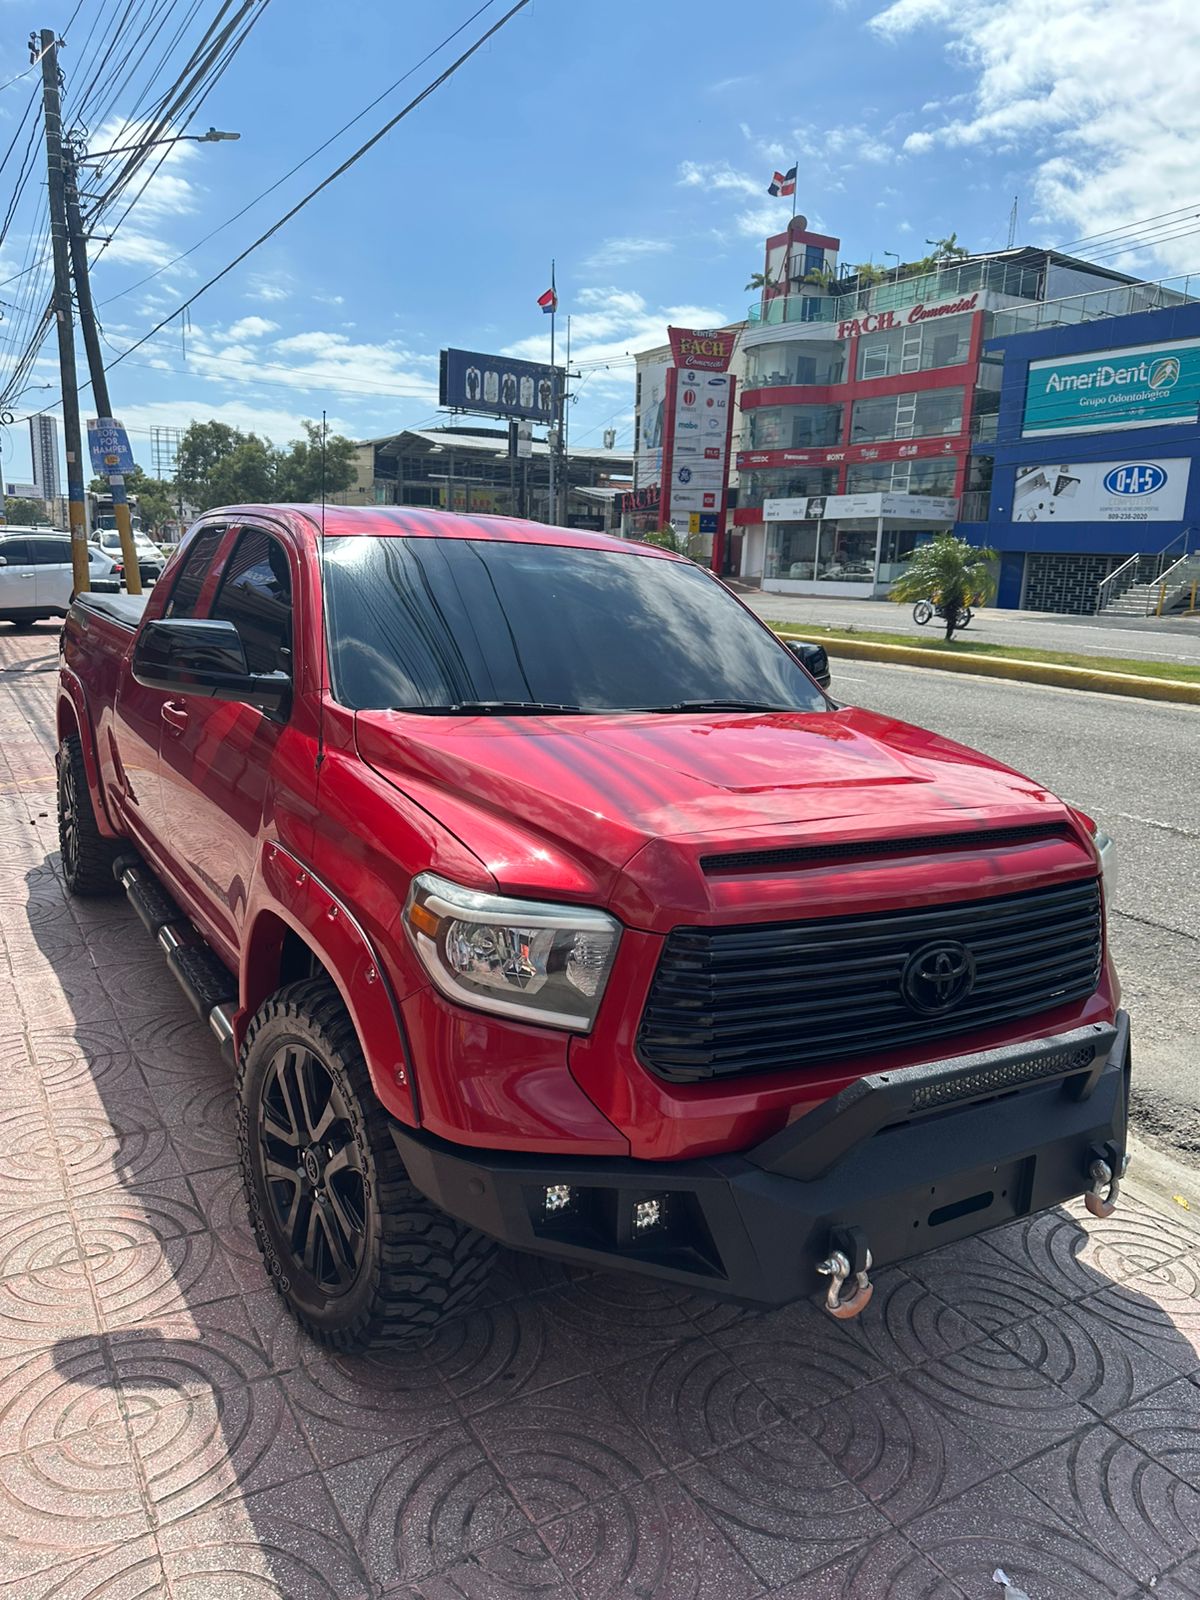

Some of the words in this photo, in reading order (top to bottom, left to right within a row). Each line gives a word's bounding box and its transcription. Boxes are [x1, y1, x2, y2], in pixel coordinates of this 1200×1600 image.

[837, 311, 902, 340] FACIL
[907, 293, 979, 324] Comercial
[679, 339, 730, 357] FACIL
[685, 355, 724, 368] Comercial
[1045, 361, 1149, 393] AmeriDent
[717, 400, 726, 408] LG
[1079, 396, 1107, 407] Grupo
[678, 420, 698, 430] mabe
[98, 429, 119, 437] ROPA
[100, 437, 119, 446] POR
[92, 445, 128, 455] HAMPER
[826, 453, 846, 462] SONY
